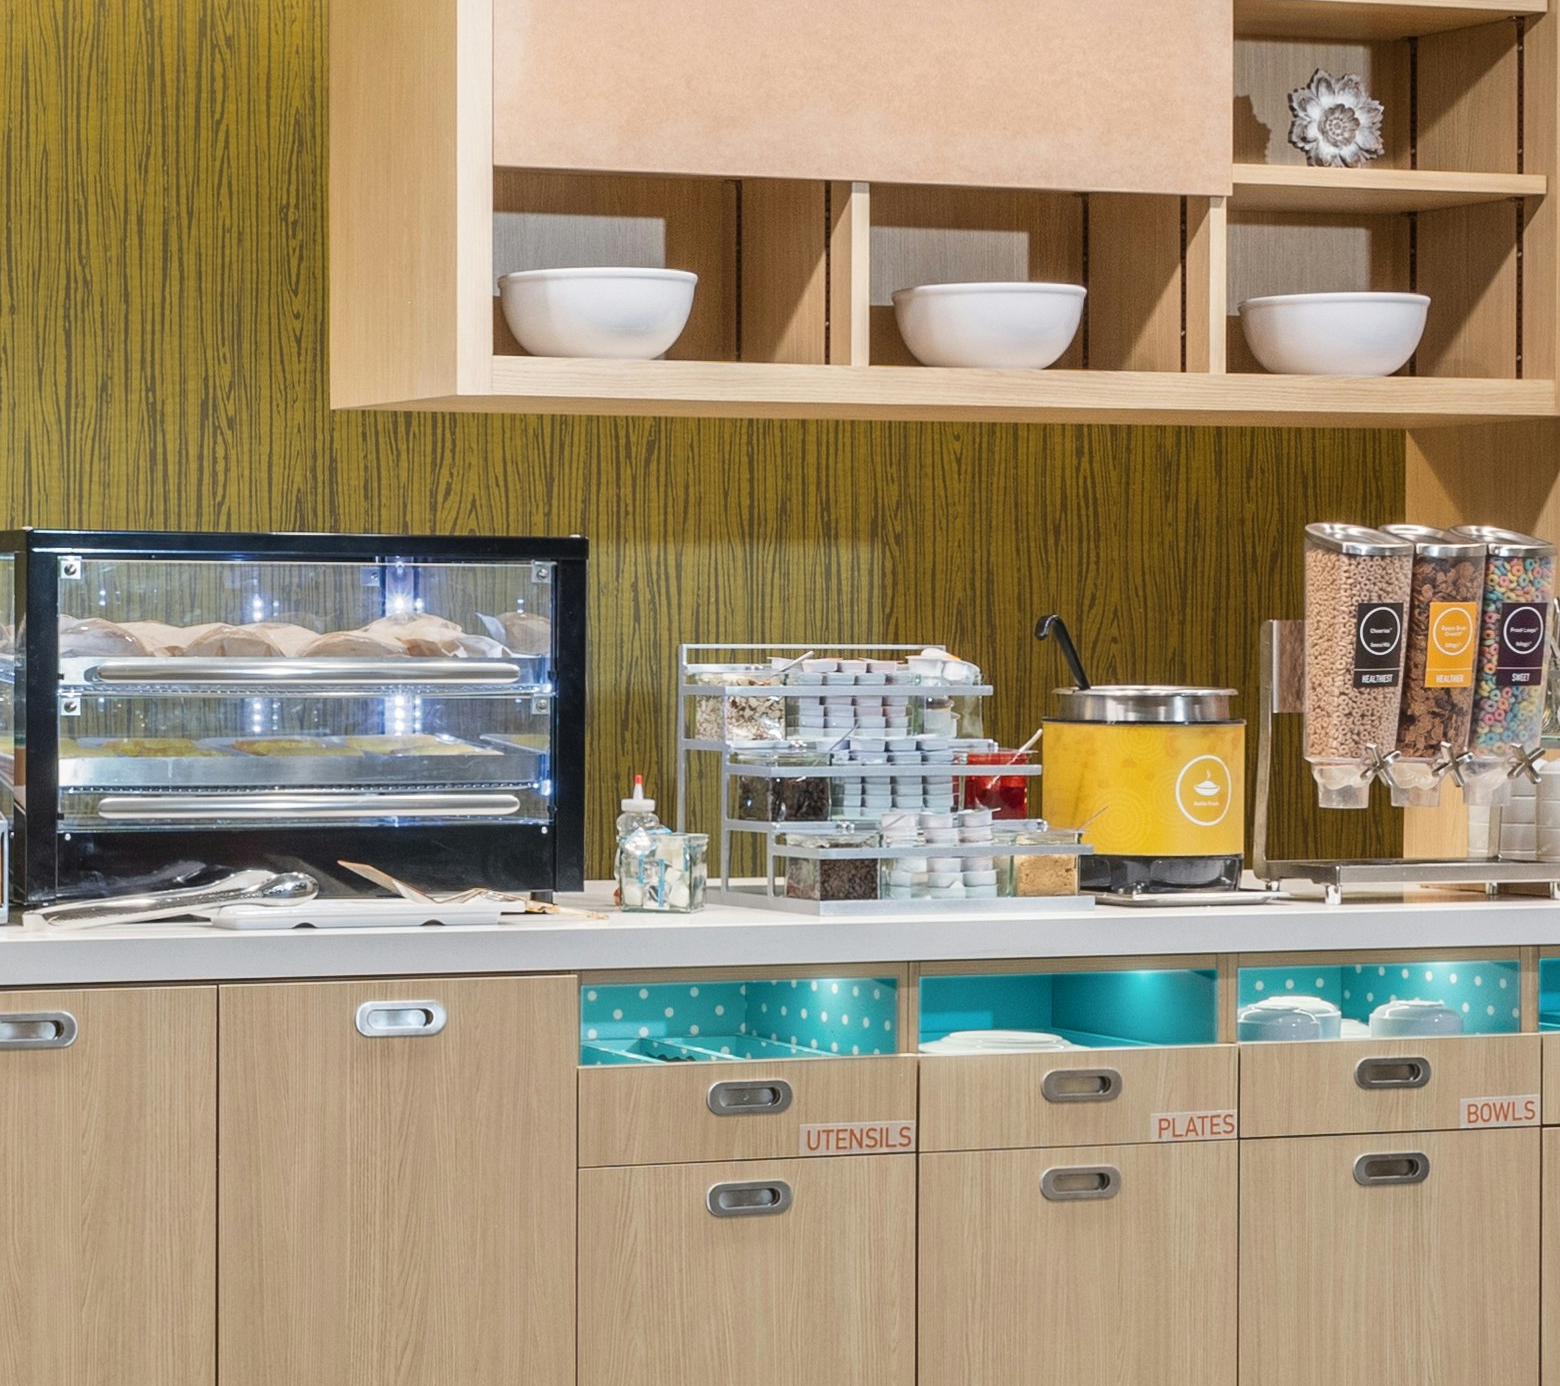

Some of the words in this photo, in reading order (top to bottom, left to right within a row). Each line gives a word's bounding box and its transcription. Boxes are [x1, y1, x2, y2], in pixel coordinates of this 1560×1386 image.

[1467, 1100, 1536, 1124] BOWLS
[807, 1126, 912, 1151] UTENSILS
[1158, 1114, 1235, 1139] PLATES
